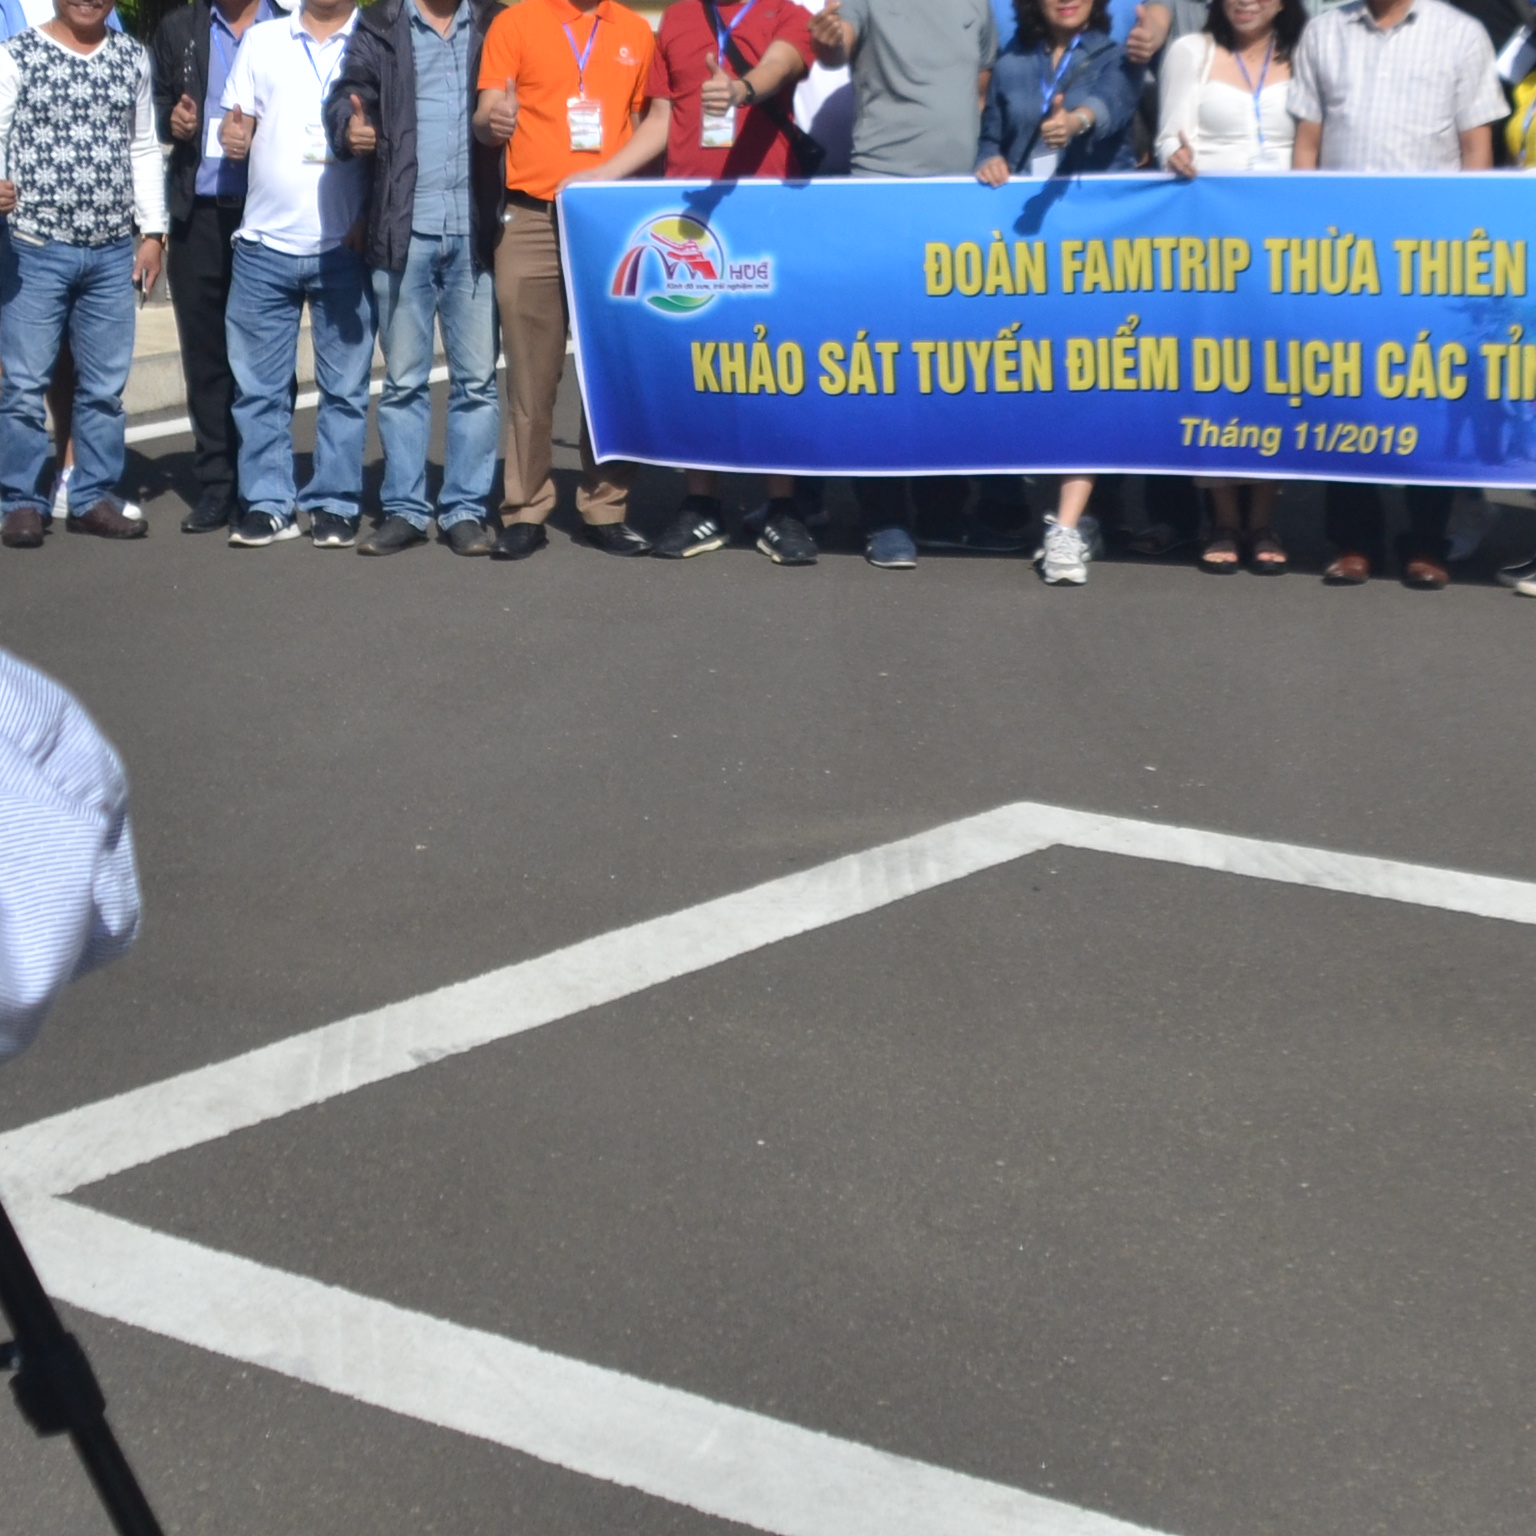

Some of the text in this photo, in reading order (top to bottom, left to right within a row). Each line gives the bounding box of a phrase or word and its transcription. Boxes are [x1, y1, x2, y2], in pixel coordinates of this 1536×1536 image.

[923, 229, 1047, 297] ĐOÀN
[1061, 236, 1252, 294] FAMTRIP
[1264, 225, 1381, 295] THỪA
[1393, 227, 1527, 297] THIÊN
[691, 324, 806, 396] KHẢO
[818, 330, 900, 396] SÁT
[910, 322, 1055, 394] TUYẾN
[1065, 314, 1180, 392] ĐIỂM
[1192, 338, 1253, 394] DU
[1264, 338, 1363, 408] LỊCH
[1376, 330, 1468, 401] CÁC
[1180, 416, 1419, 457] Tháng 11/2019
